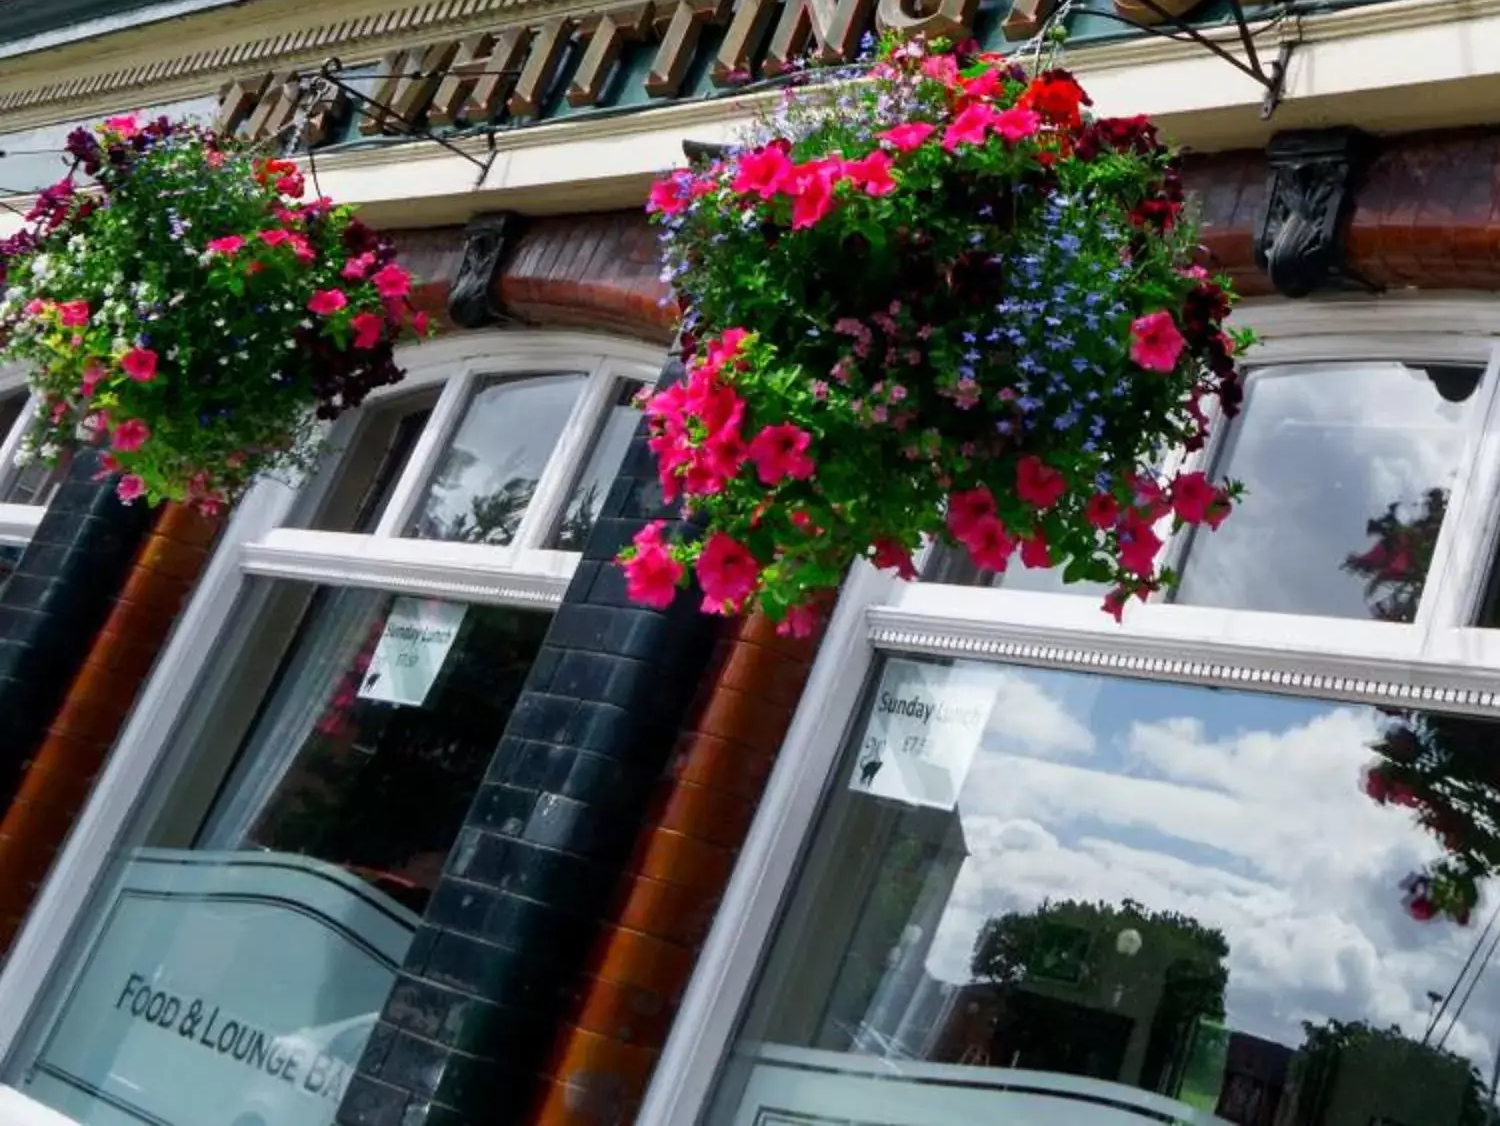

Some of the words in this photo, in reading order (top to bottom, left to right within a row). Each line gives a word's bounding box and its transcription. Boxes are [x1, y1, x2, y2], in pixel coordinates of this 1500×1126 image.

[879, 691, 935, 725] Sunday
[116, 973, 182, 1030] FOOD
[178, 998, 204, 1041] &
[200, 1006, 301, 1084] LOUNGE
